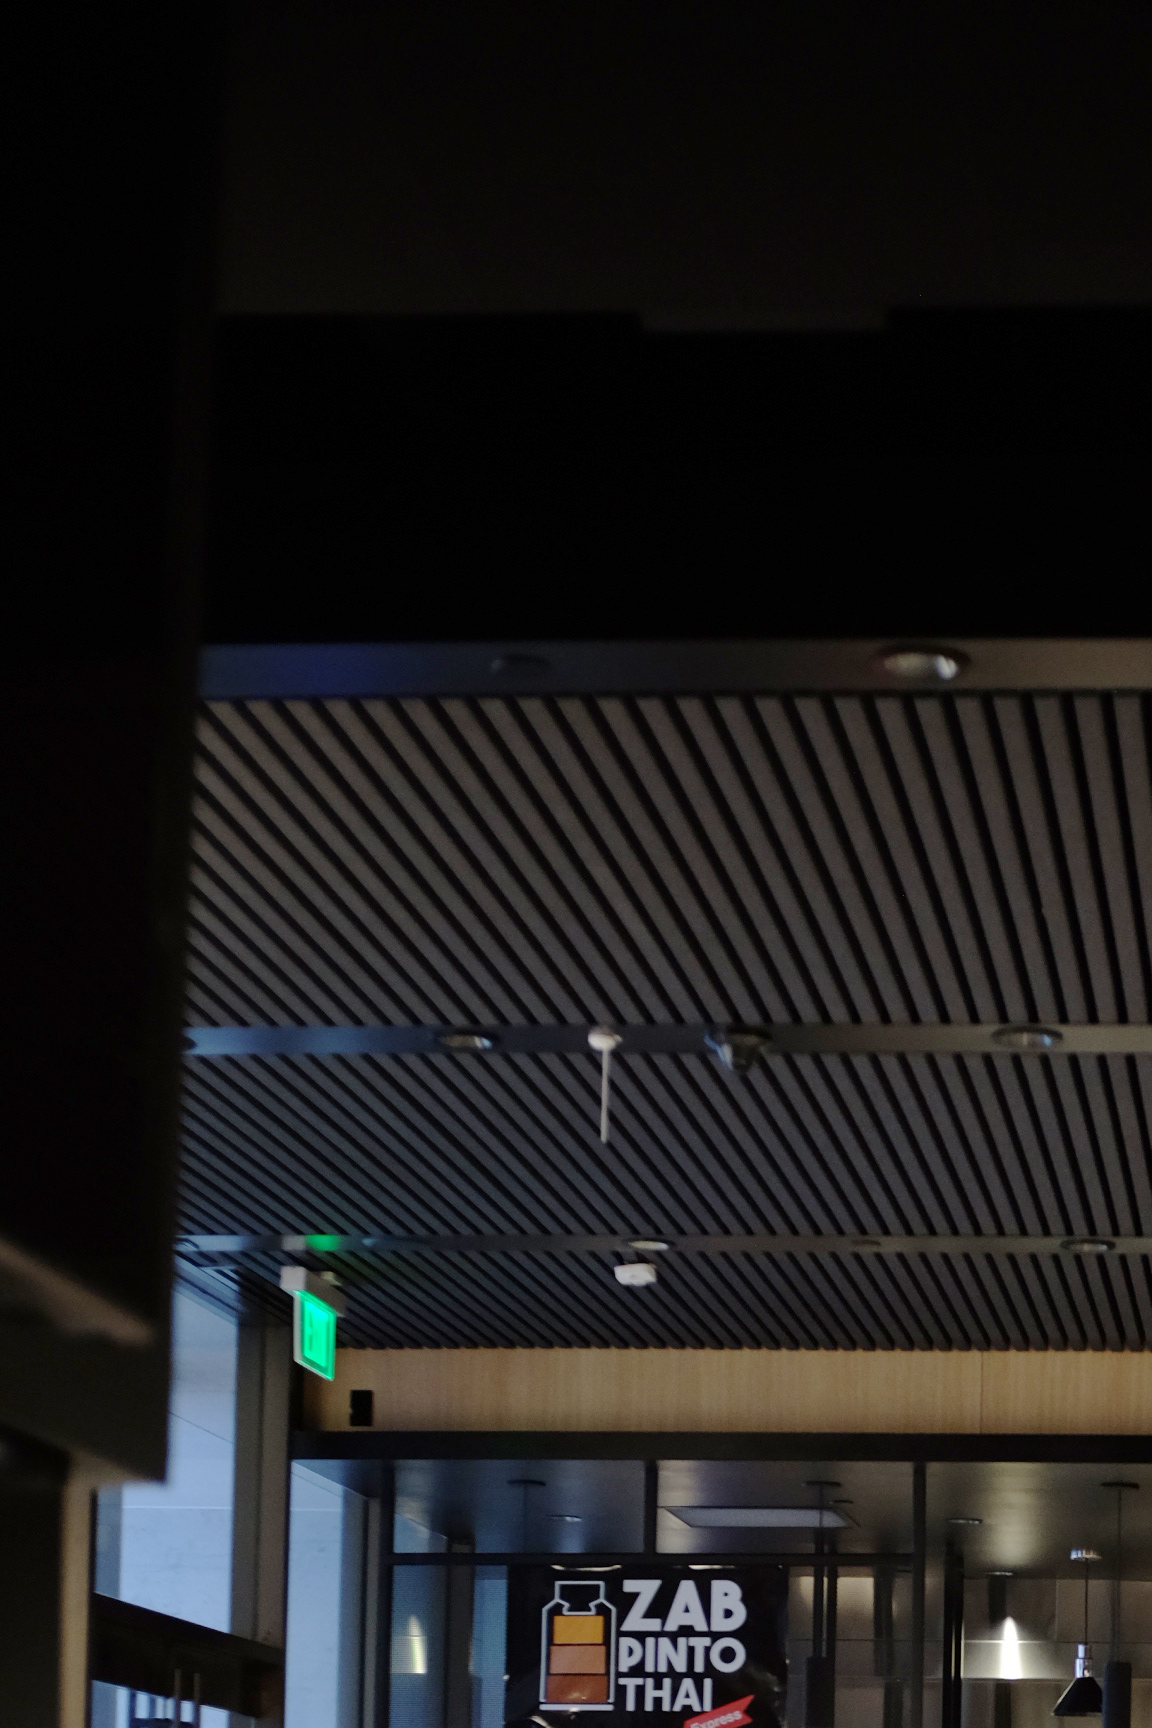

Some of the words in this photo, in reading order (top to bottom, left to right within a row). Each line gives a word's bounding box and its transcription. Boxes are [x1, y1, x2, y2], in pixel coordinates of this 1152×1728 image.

[620, 1579, 747, 1632] ZAB
[618, 1637, 746, 1673] PINTO
[618, 1677, 713, 1712] THAI
